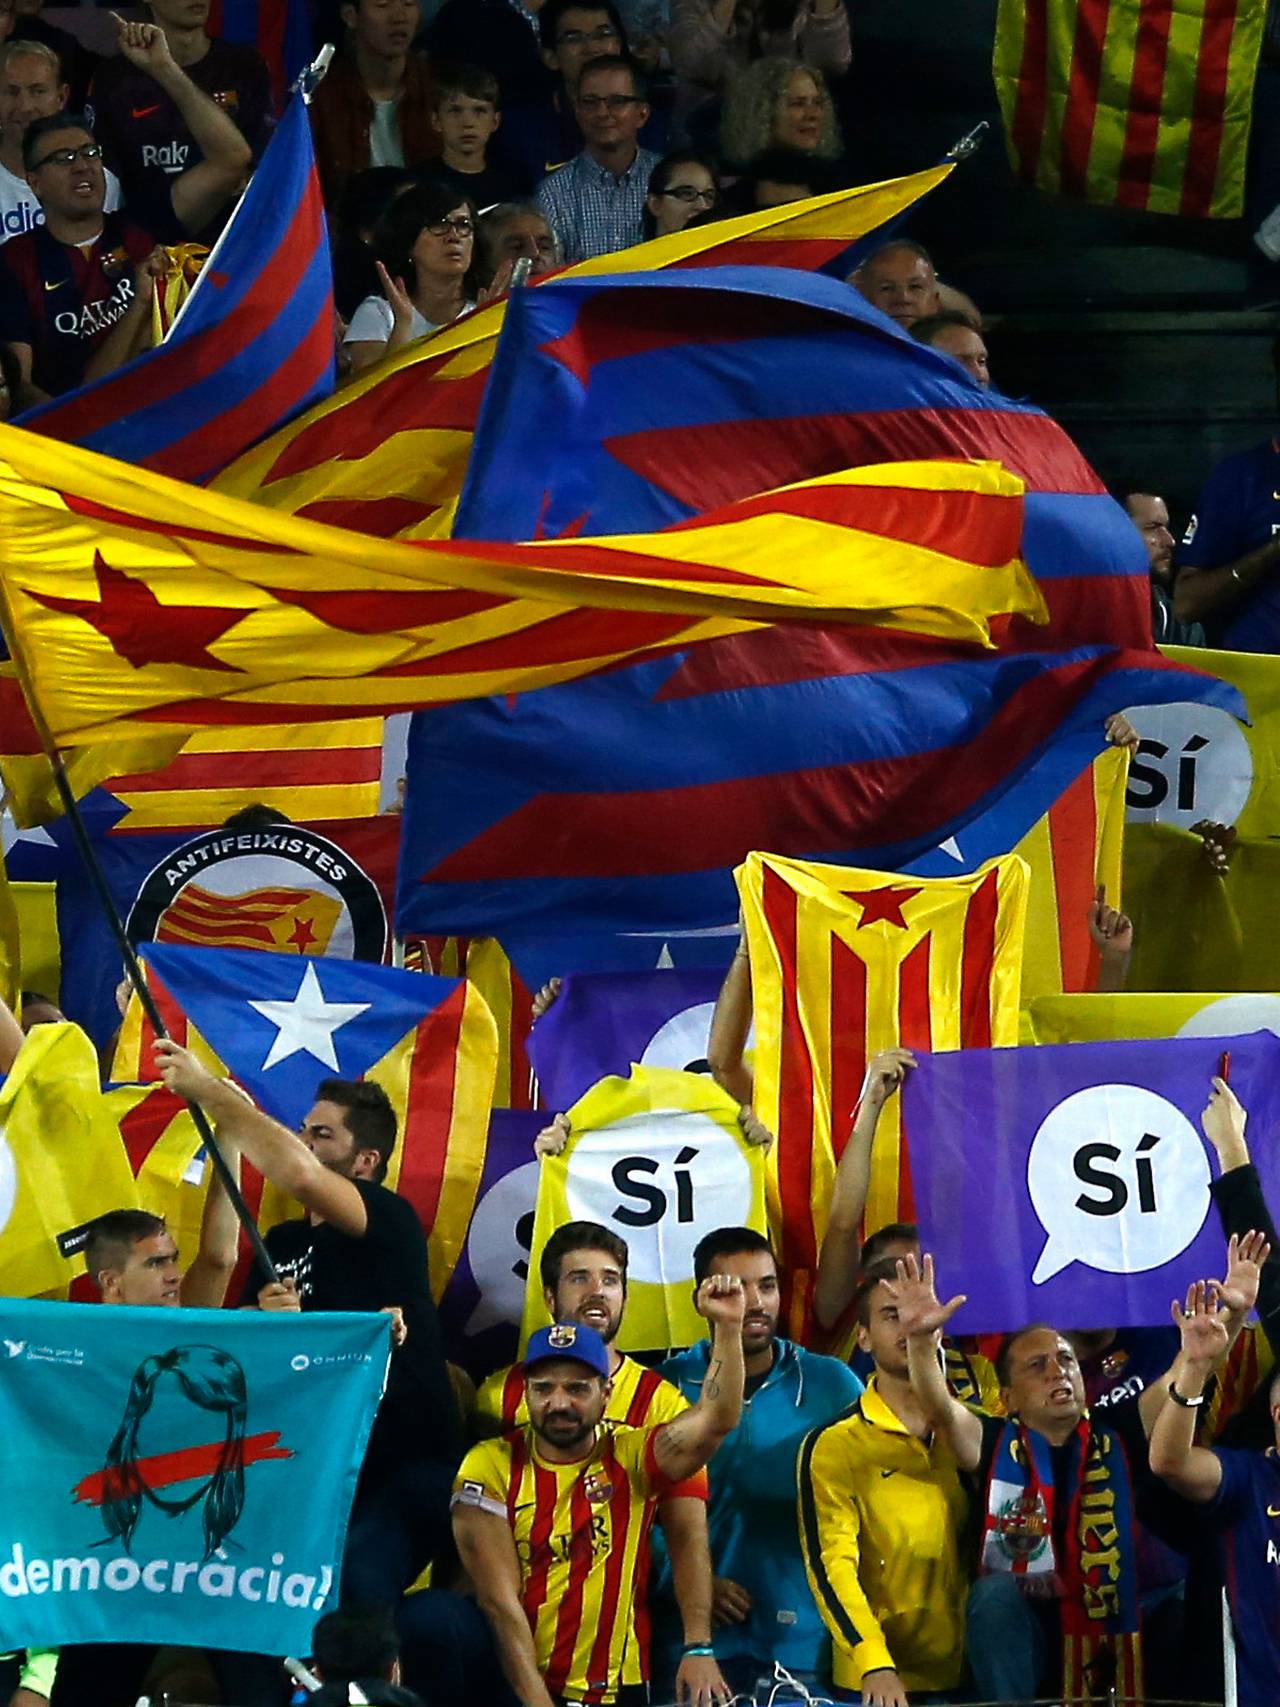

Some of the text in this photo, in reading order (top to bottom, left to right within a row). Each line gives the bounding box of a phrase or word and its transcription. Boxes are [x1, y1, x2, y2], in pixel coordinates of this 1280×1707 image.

[55, 278, 135, 335] QATAR
[1125, 734, 1210, 811] Sí
[164, 834, 348, 886] ANTIFEIXISTES
[611, 1146, 700, 1228] Sí
[1073, 1133, 1161, 1216] Sí
